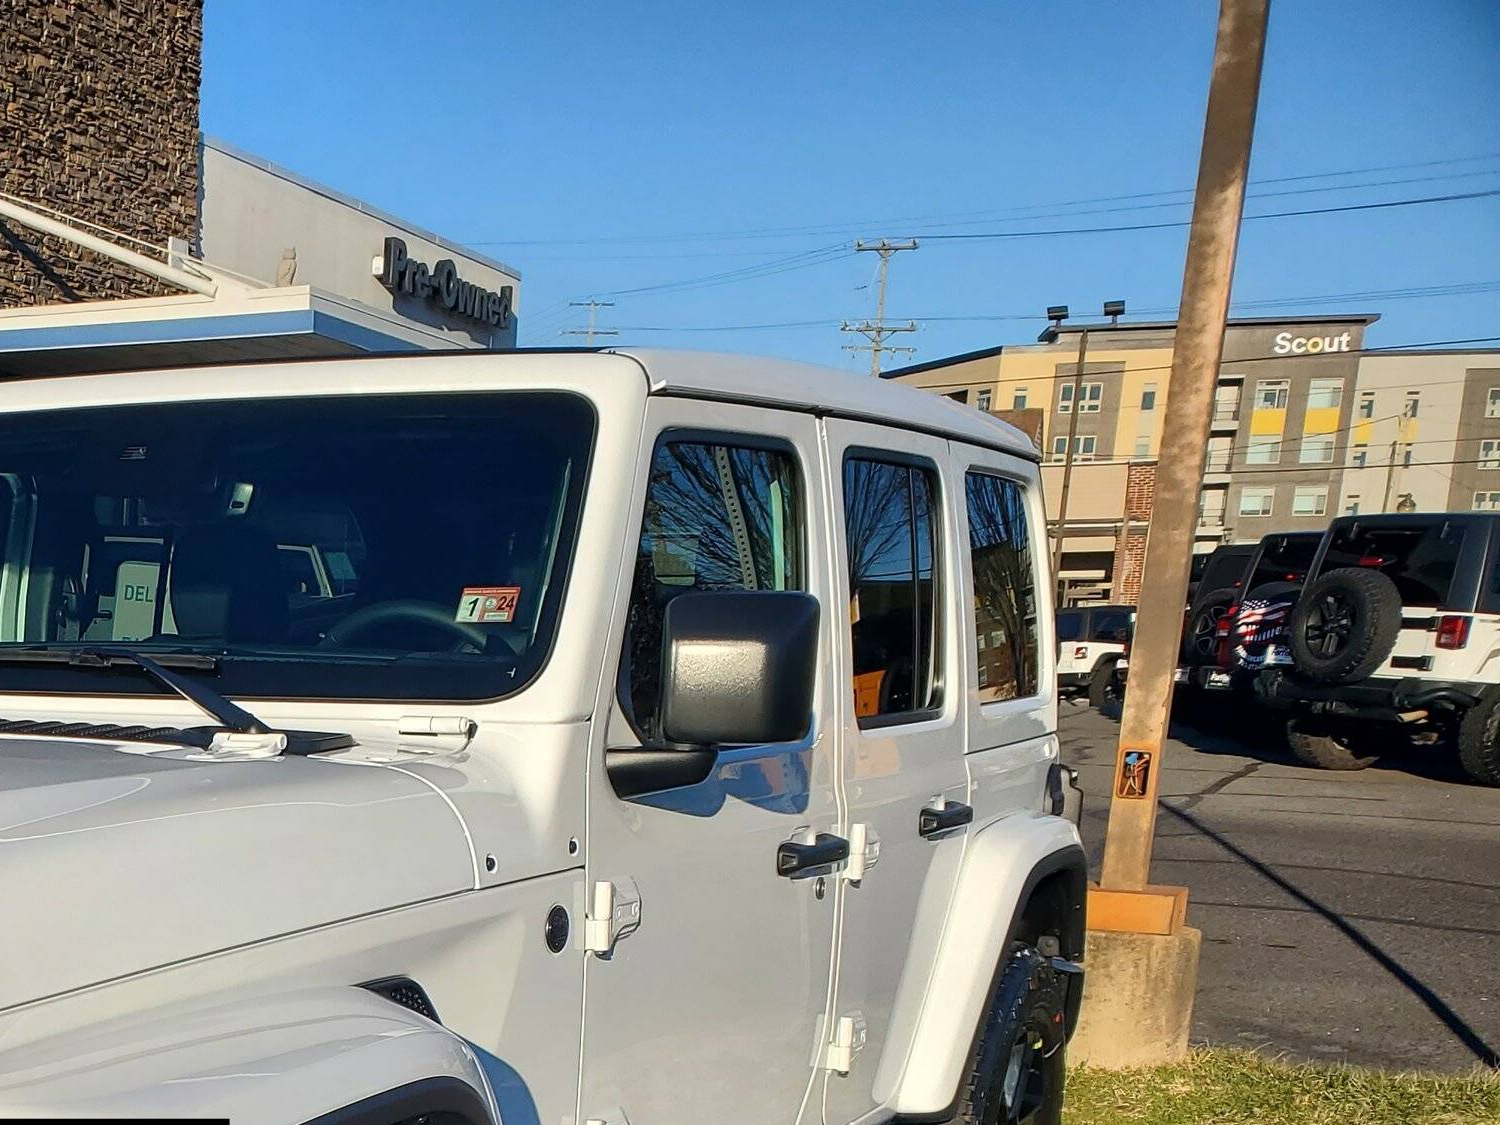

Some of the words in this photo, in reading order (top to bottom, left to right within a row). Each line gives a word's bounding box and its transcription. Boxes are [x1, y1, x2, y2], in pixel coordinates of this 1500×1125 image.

[384, 236, 514, 329] Pre-Owned
[1273, 332, 1351, 354] Scout
[468, 597, 480, 617] 1
[496, 595, 517, 611] 24
